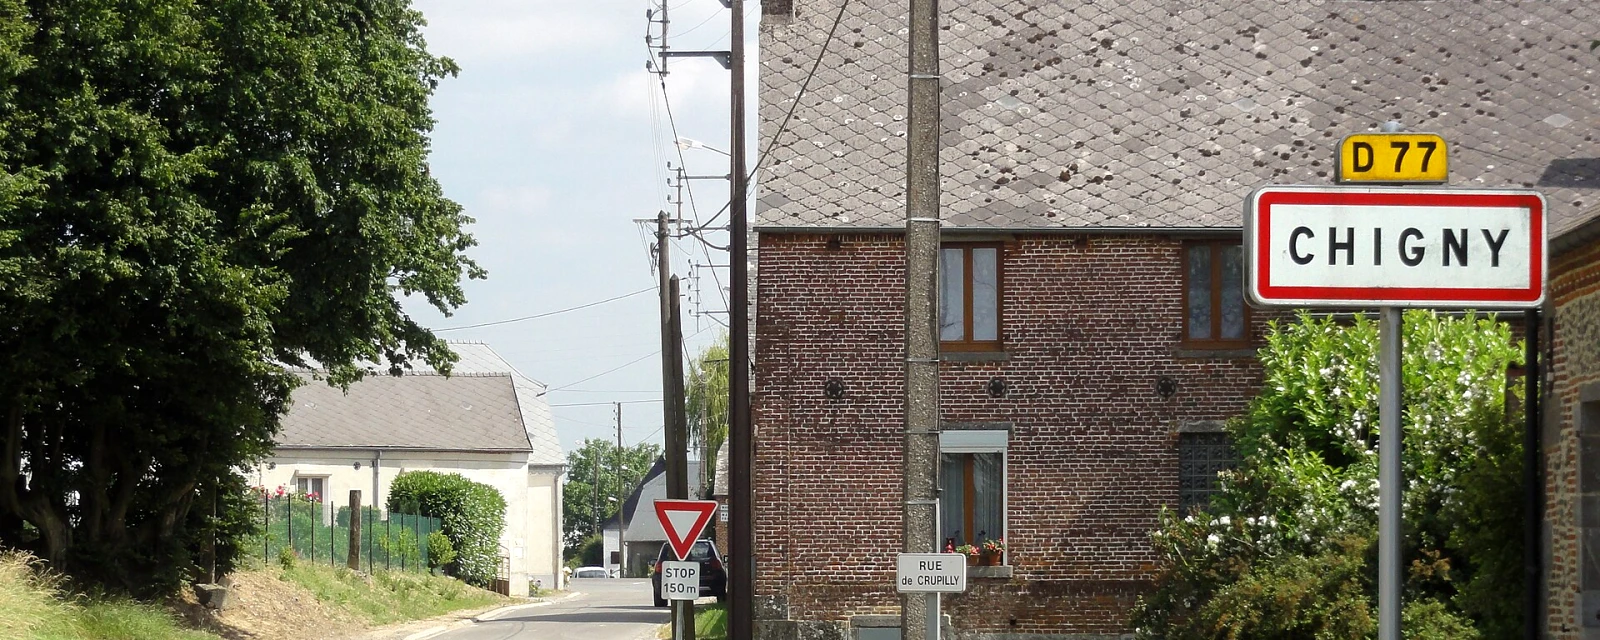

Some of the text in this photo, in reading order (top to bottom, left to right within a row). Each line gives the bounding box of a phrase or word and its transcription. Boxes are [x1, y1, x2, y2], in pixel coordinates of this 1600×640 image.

[1352, 141, 1438, 173] D 77
[1288, 226, 1511, 268] CHIGNY
[919, 560, 943, 571] RUE
[665, 567, 696, 579] STOP
[901, 575, 960, 586] de CRUPILLY
